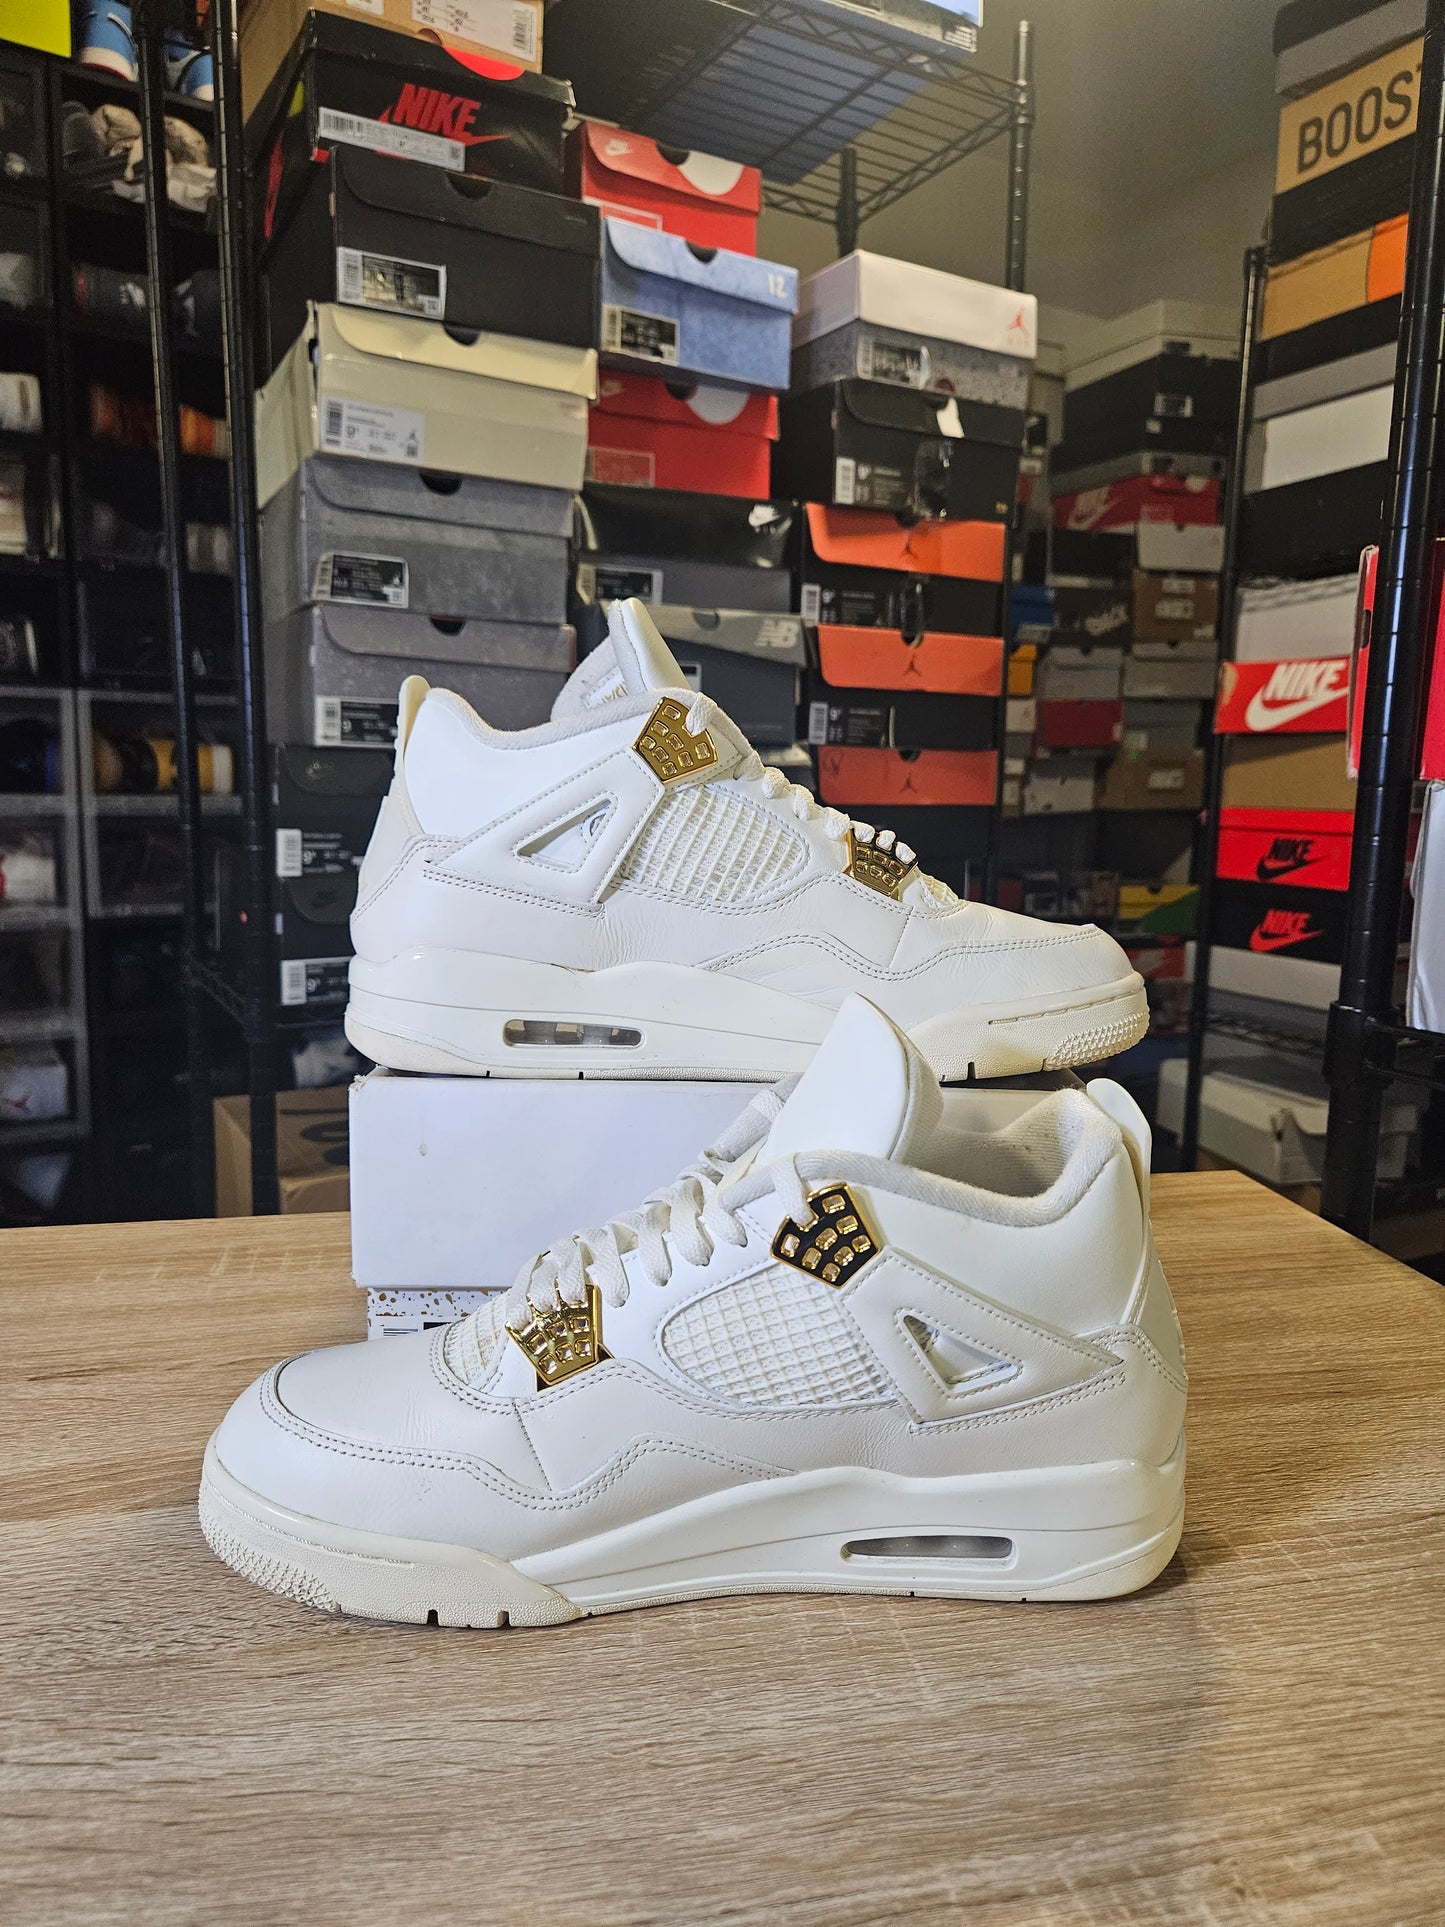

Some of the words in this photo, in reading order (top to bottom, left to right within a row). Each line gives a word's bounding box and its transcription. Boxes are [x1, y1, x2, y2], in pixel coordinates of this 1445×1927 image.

[392, 82, 482, 140] NIKE
[1297, 63, 1421, 173] BOOS
[767, 272, 790, 299] 12
[1263, 659, 1346, 701] NIKE
[1266, 837, 1314, 862] NIKE
[1260, 909, 1312, 936] NIKE
